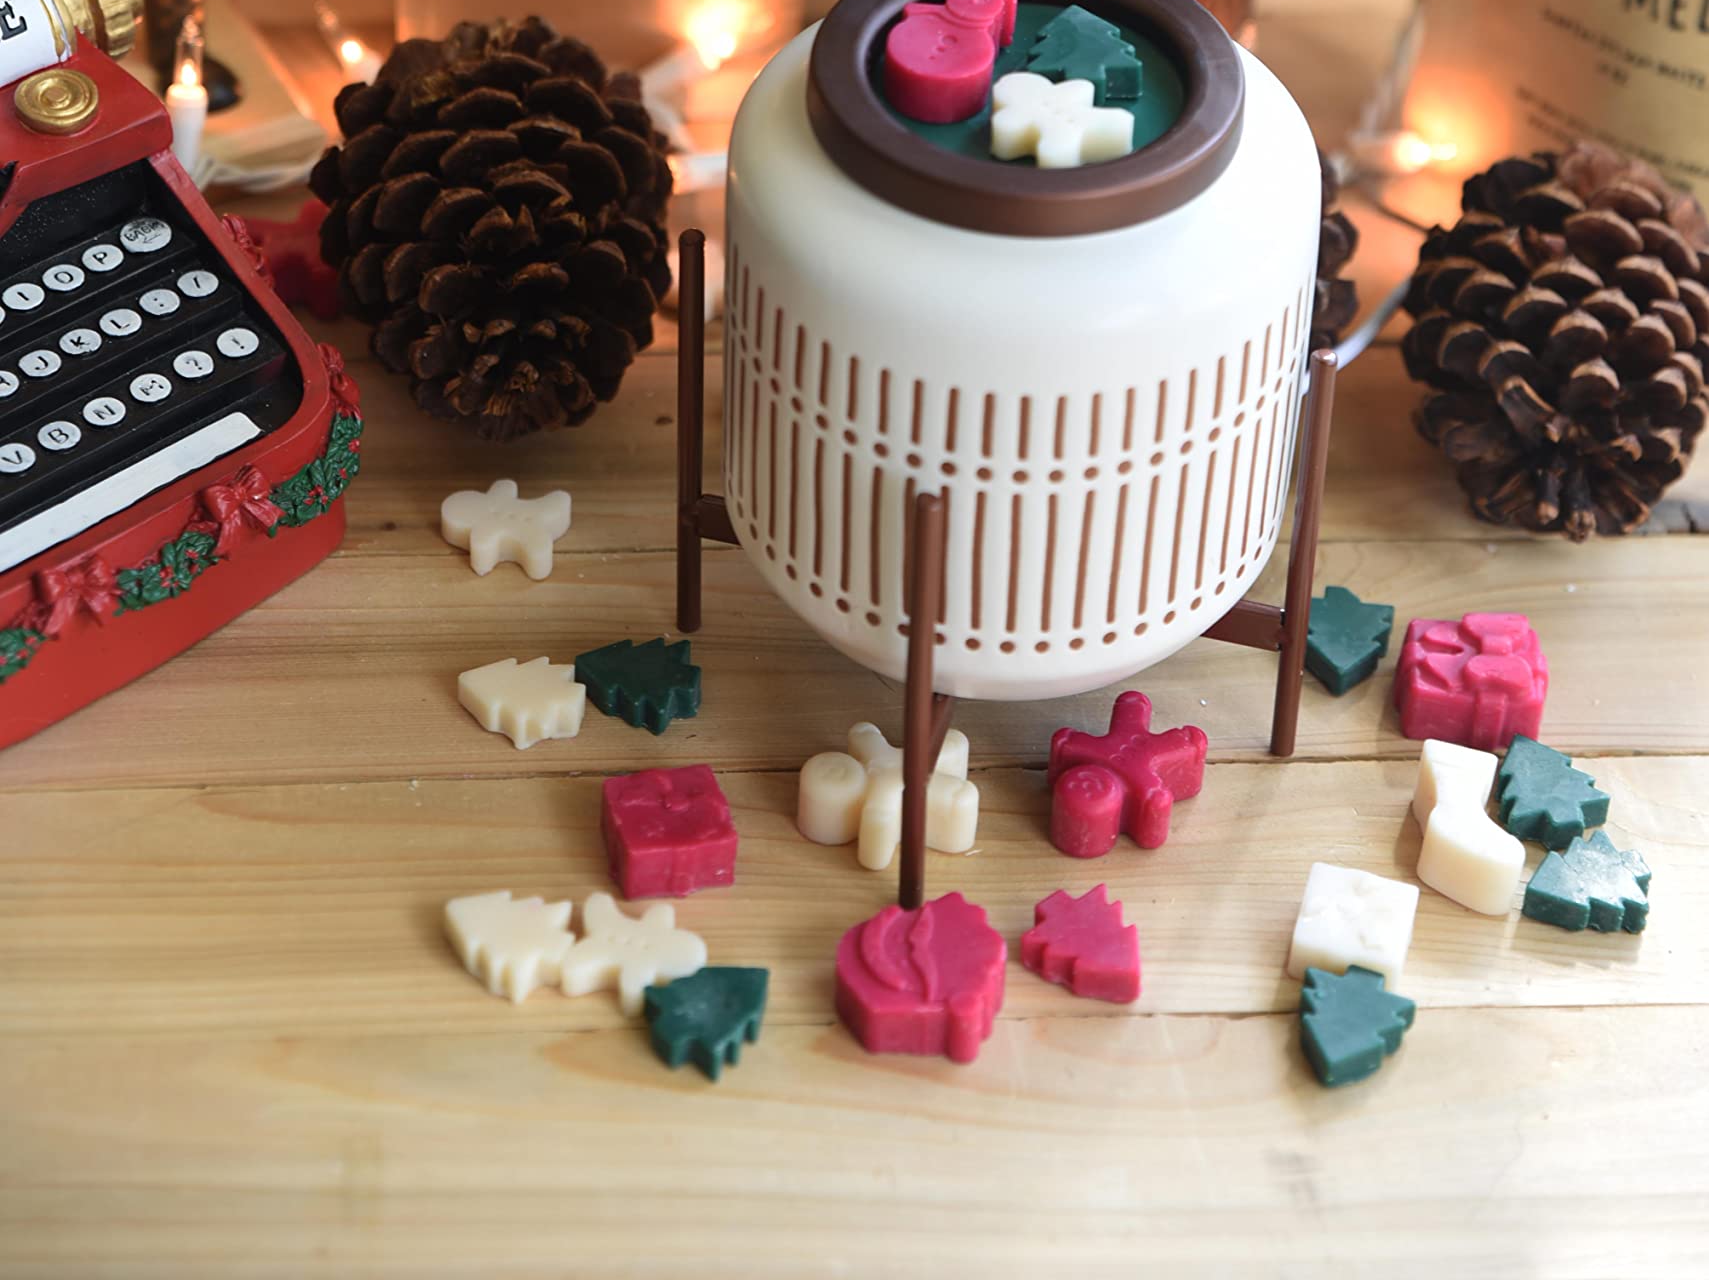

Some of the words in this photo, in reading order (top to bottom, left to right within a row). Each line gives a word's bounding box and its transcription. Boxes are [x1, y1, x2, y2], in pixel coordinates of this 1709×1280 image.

[53, 271, 74, 285] O
[92, 251, 108, 265] P
[34, 356, 49, 371] J
[69, 335, 91, 348] K
[109, 318, 131, 330] L
[2, 450, 23, 465] V
[47, 427, 69, 445] B
[92, 404, 117, 421] N
[138, 379, 164, 397] M
[185, 357, 203, 371] ?
[231, 335, 245, 350] !
